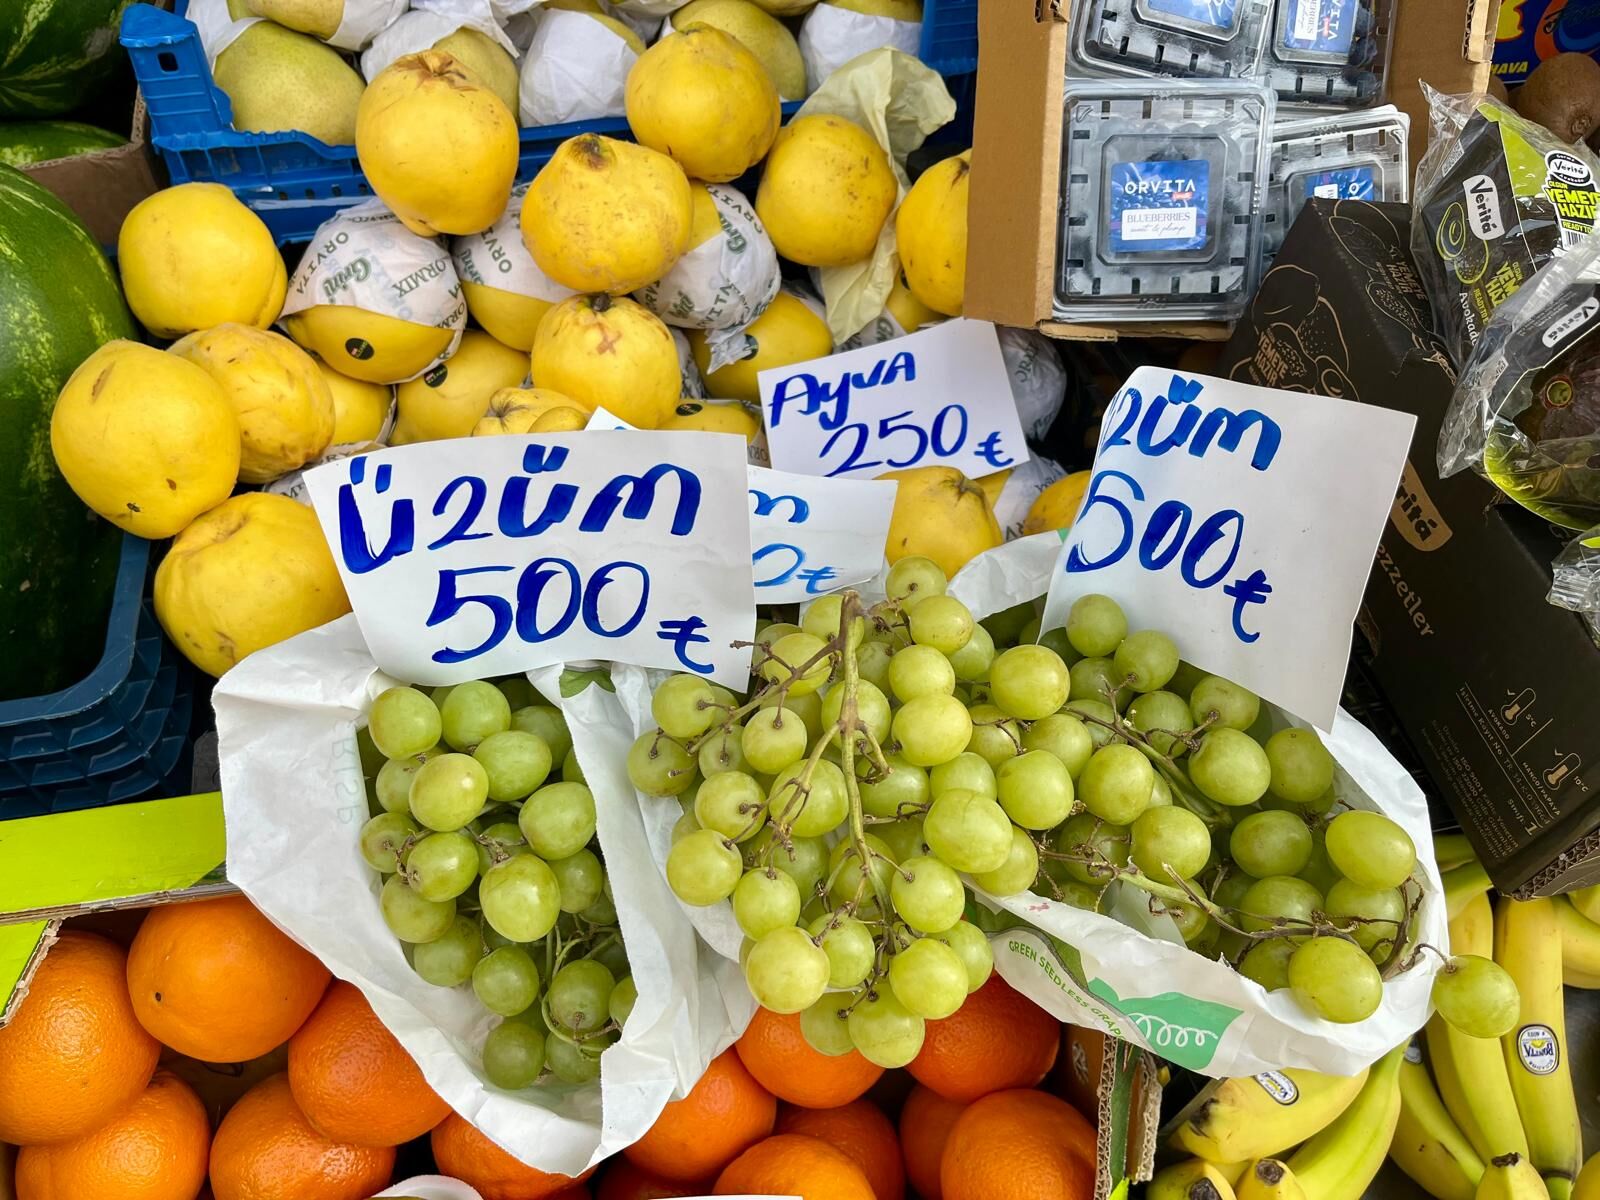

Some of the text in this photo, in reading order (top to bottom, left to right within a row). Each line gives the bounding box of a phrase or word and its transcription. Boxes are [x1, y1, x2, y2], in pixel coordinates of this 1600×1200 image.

[1125, 179, 1196, 194] ORVITA
[1127, 212, 1191, 223] BLUEBERRIES
[296, 231, 349, 295] ORVITA
[481, 225, 512, 274] ORVI
[391, 259, 447, 299] ORMIX
[1485, 280, 1506, 308] HAZ
[1496, 261, 1520, 296] YEM
[434, 301, 466, 329] ORM
[1396, 492, 1438, 542] ritá
[1376, 543, 1435, 636] ezzetler
[1008, 940, 1038, 962] GREEN
[1039, 955, 1090, 1009] SEEDLESS
